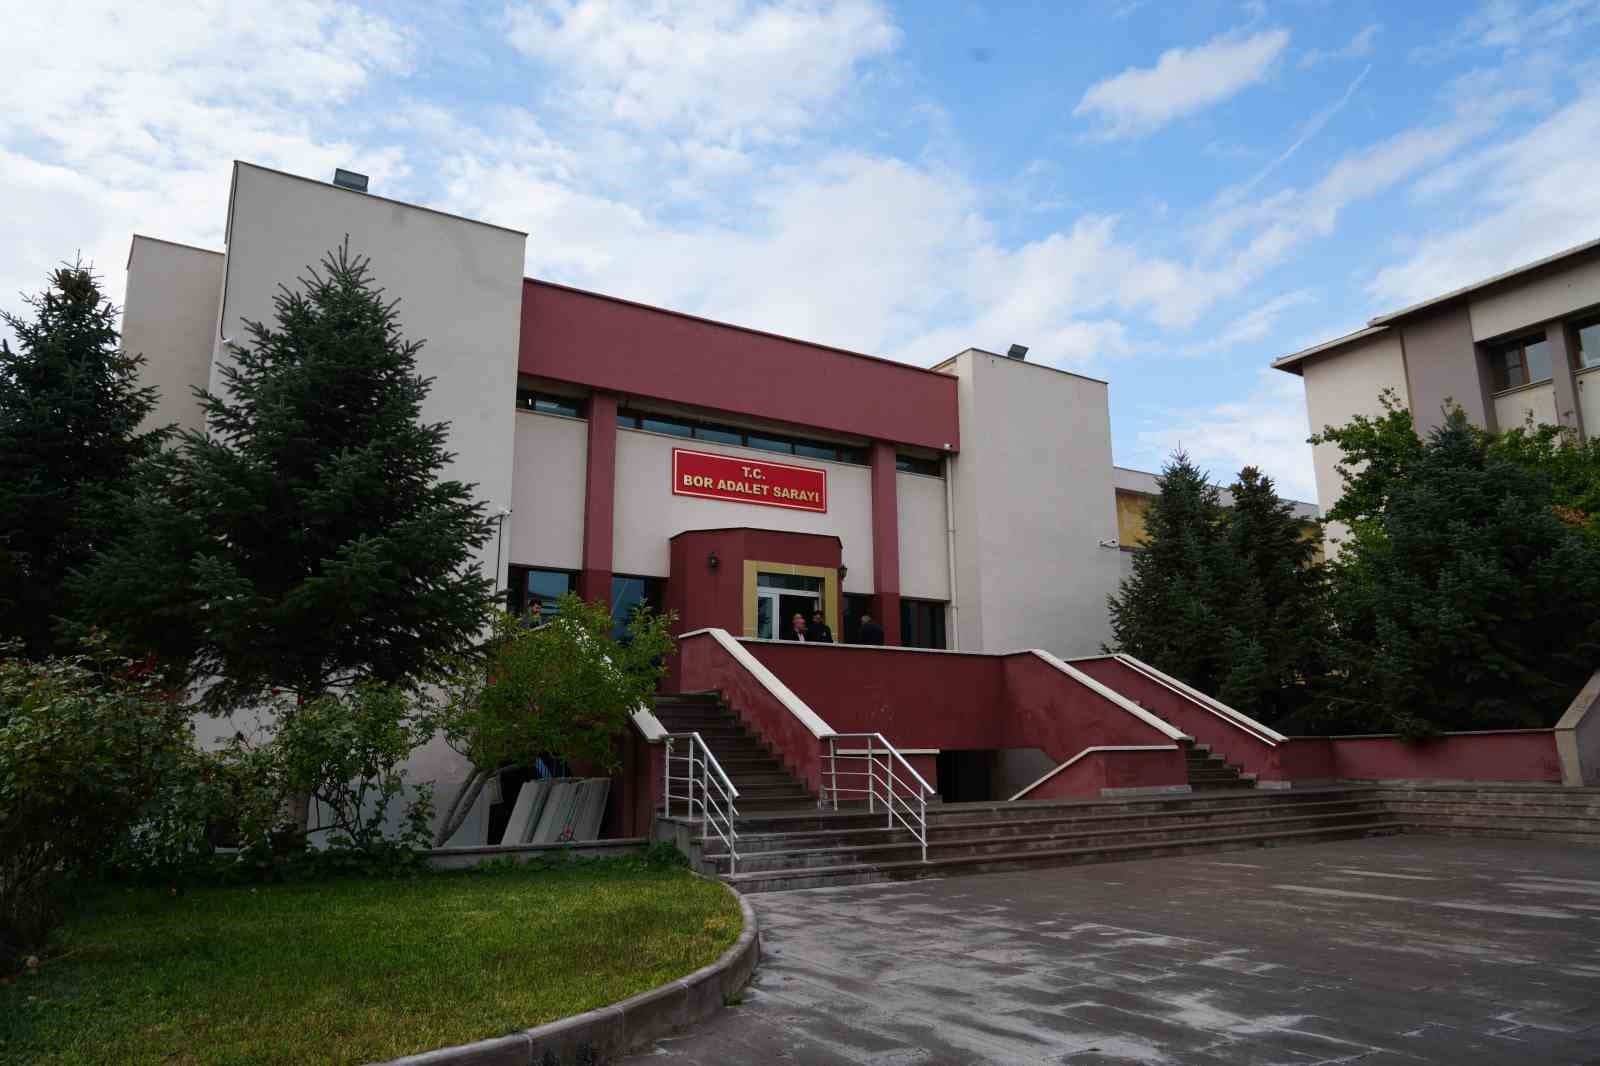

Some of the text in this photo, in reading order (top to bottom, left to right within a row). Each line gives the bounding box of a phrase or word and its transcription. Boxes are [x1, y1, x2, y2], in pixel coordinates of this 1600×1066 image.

[742, 466, 766, 479] T.C.
[683, 474, 819, 502] BOR ADALET SARAYI
